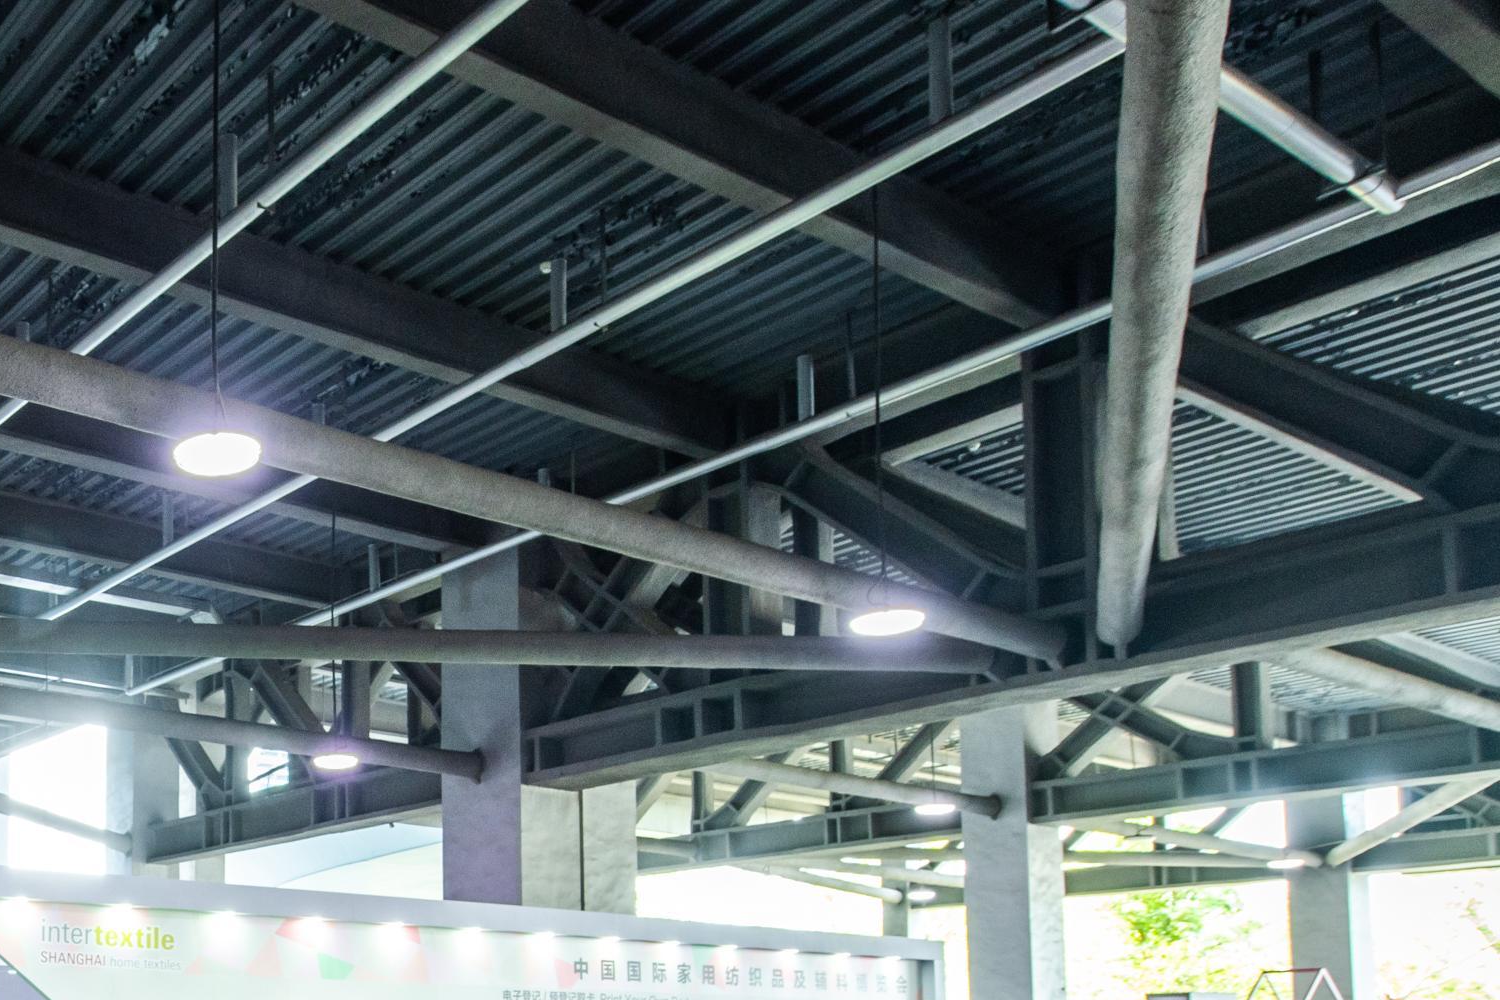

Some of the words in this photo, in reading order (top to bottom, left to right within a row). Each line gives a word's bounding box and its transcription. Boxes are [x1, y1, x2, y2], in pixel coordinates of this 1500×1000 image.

[41, 918, 175, 950] intertextile
[40, 950, 106, 966] SHANGHAI
[109, 957, 140, 968] home
[144, 958, 181, 970] textiles
